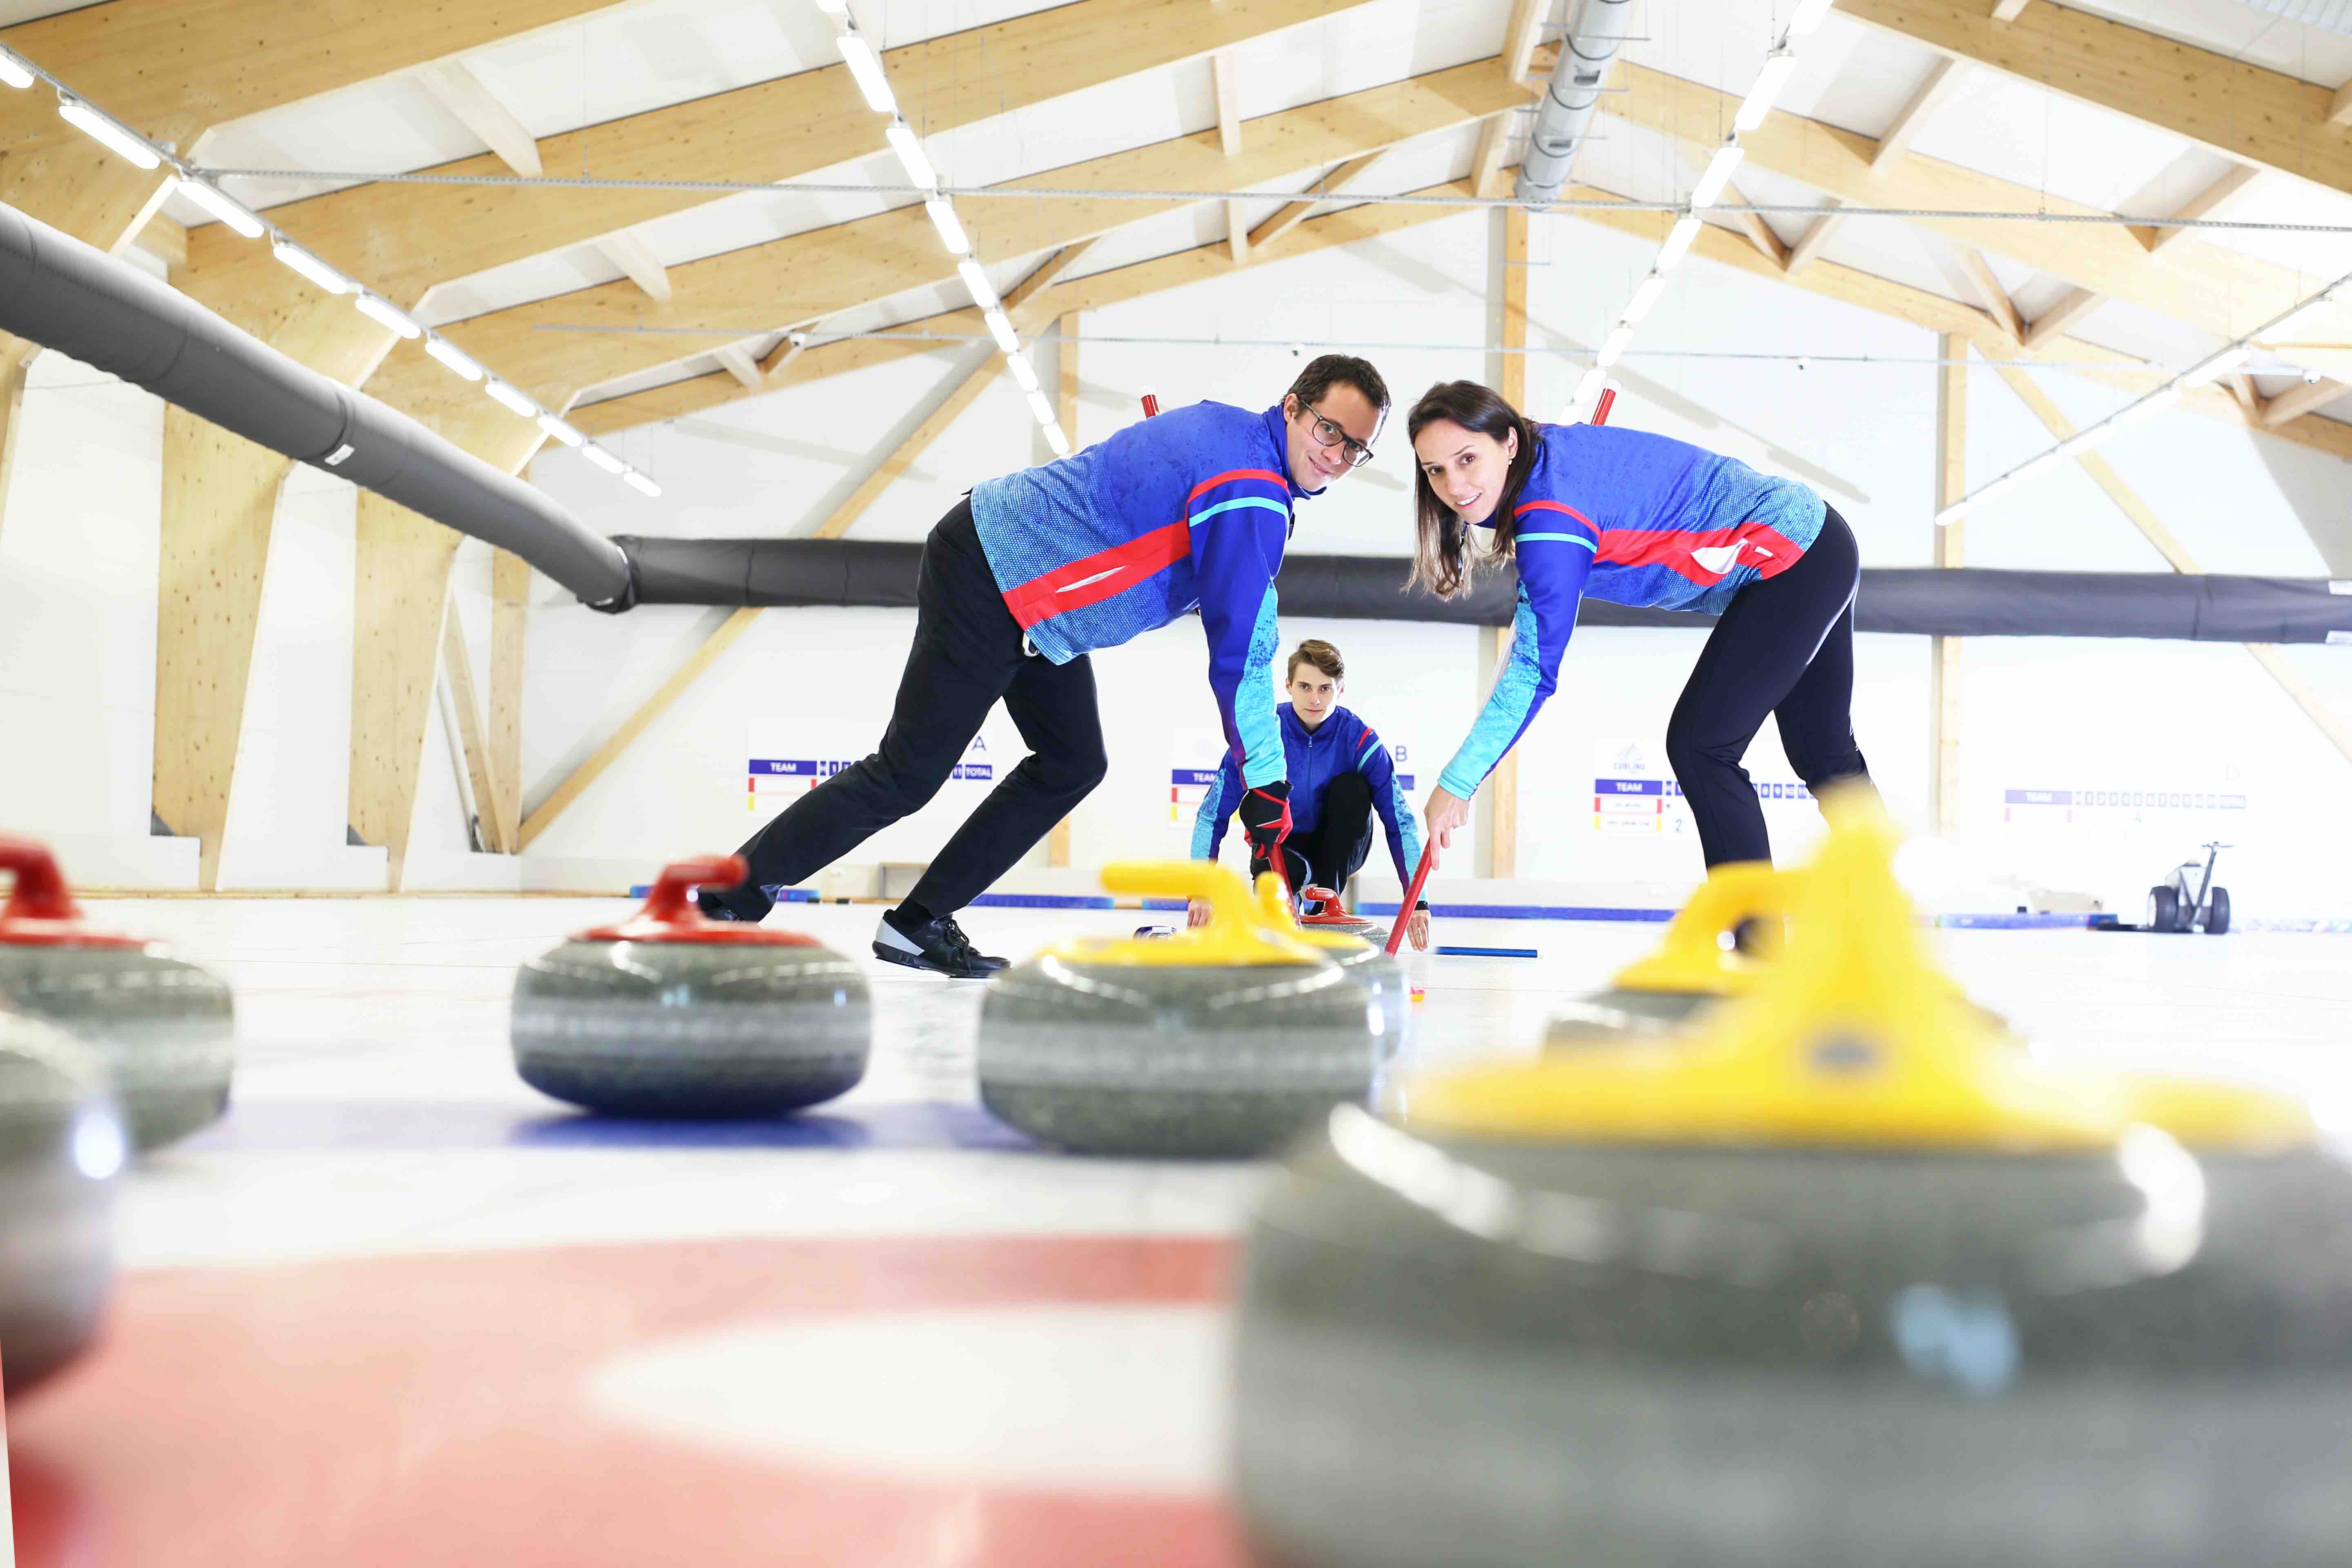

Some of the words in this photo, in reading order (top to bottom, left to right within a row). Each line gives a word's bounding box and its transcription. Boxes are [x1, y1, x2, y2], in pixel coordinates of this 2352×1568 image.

[972, 736, 986, 751] A
[1396, 746, 1407, 762] B
[770, 762, 797, 773] TEAM
[966, 767, 991, 777] TOTAL
[1616, 782, 1643, 792] TEAM
